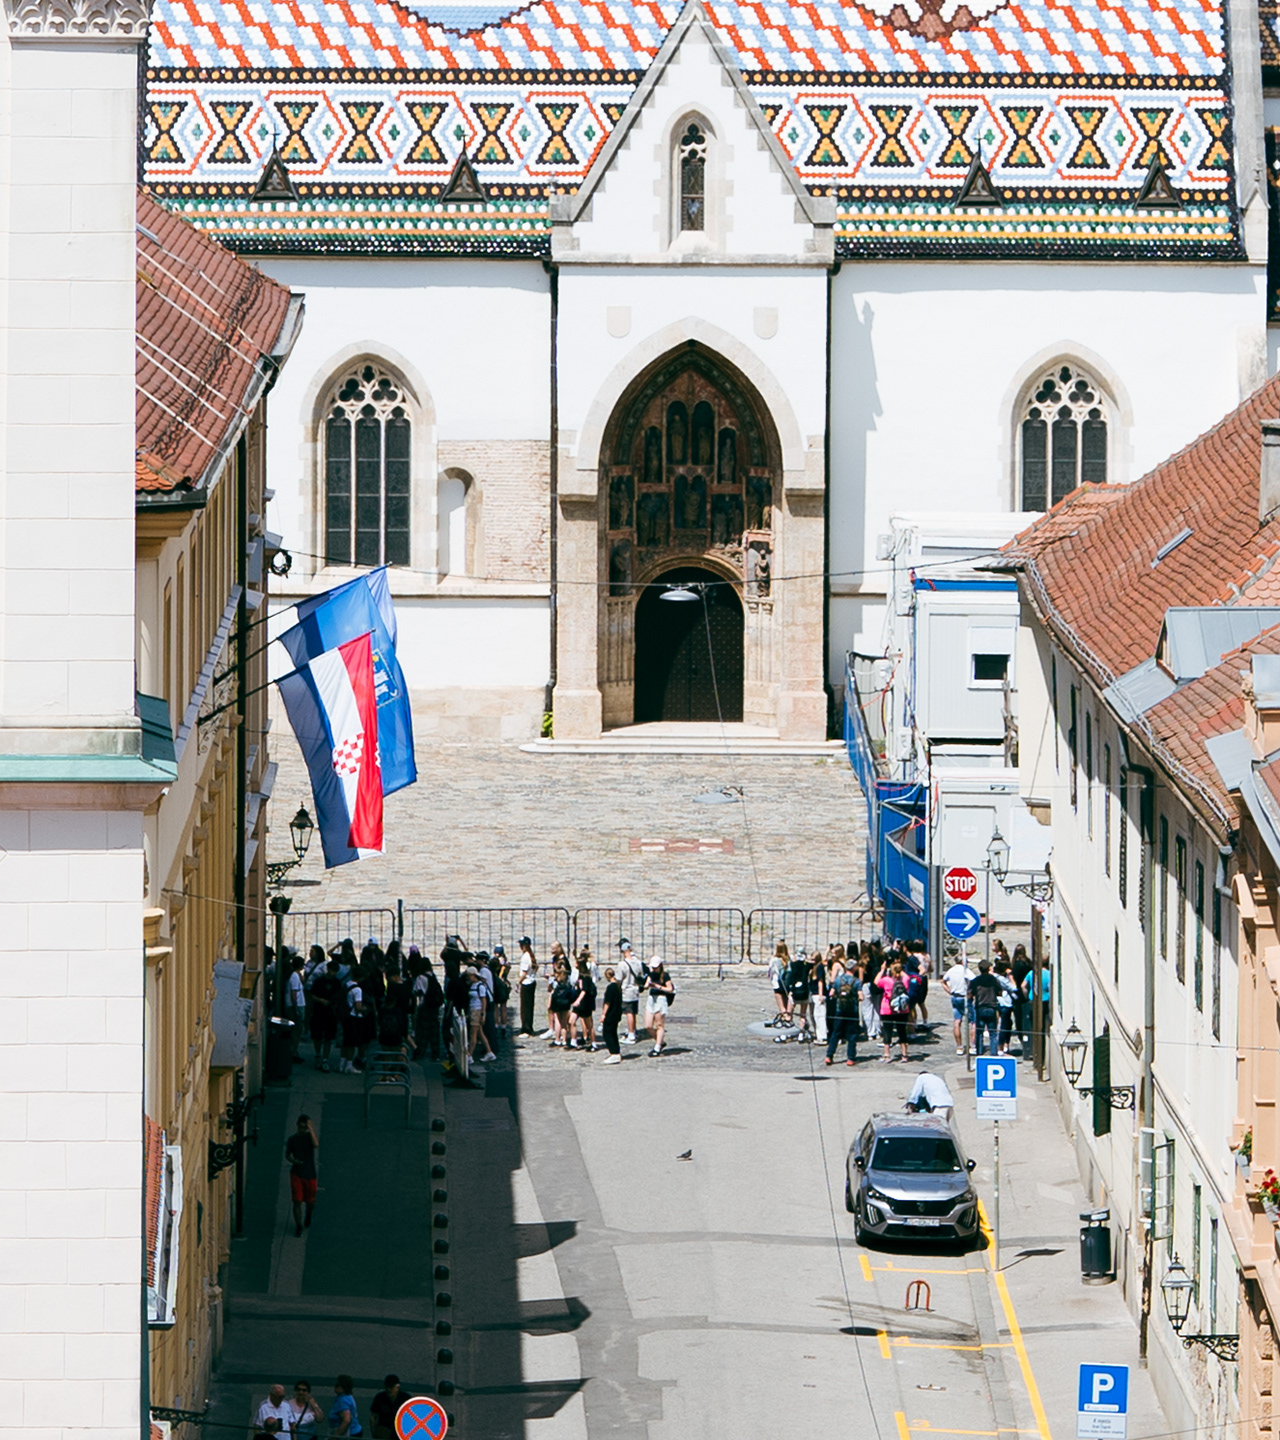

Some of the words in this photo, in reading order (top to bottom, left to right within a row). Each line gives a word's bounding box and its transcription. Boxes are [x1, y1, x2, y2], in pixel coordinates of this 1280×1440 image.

[946, 876, 976, 892] STOP
[987, 1064, 1005, 1090] P
[1092, 1373, 1115, 1404] P
